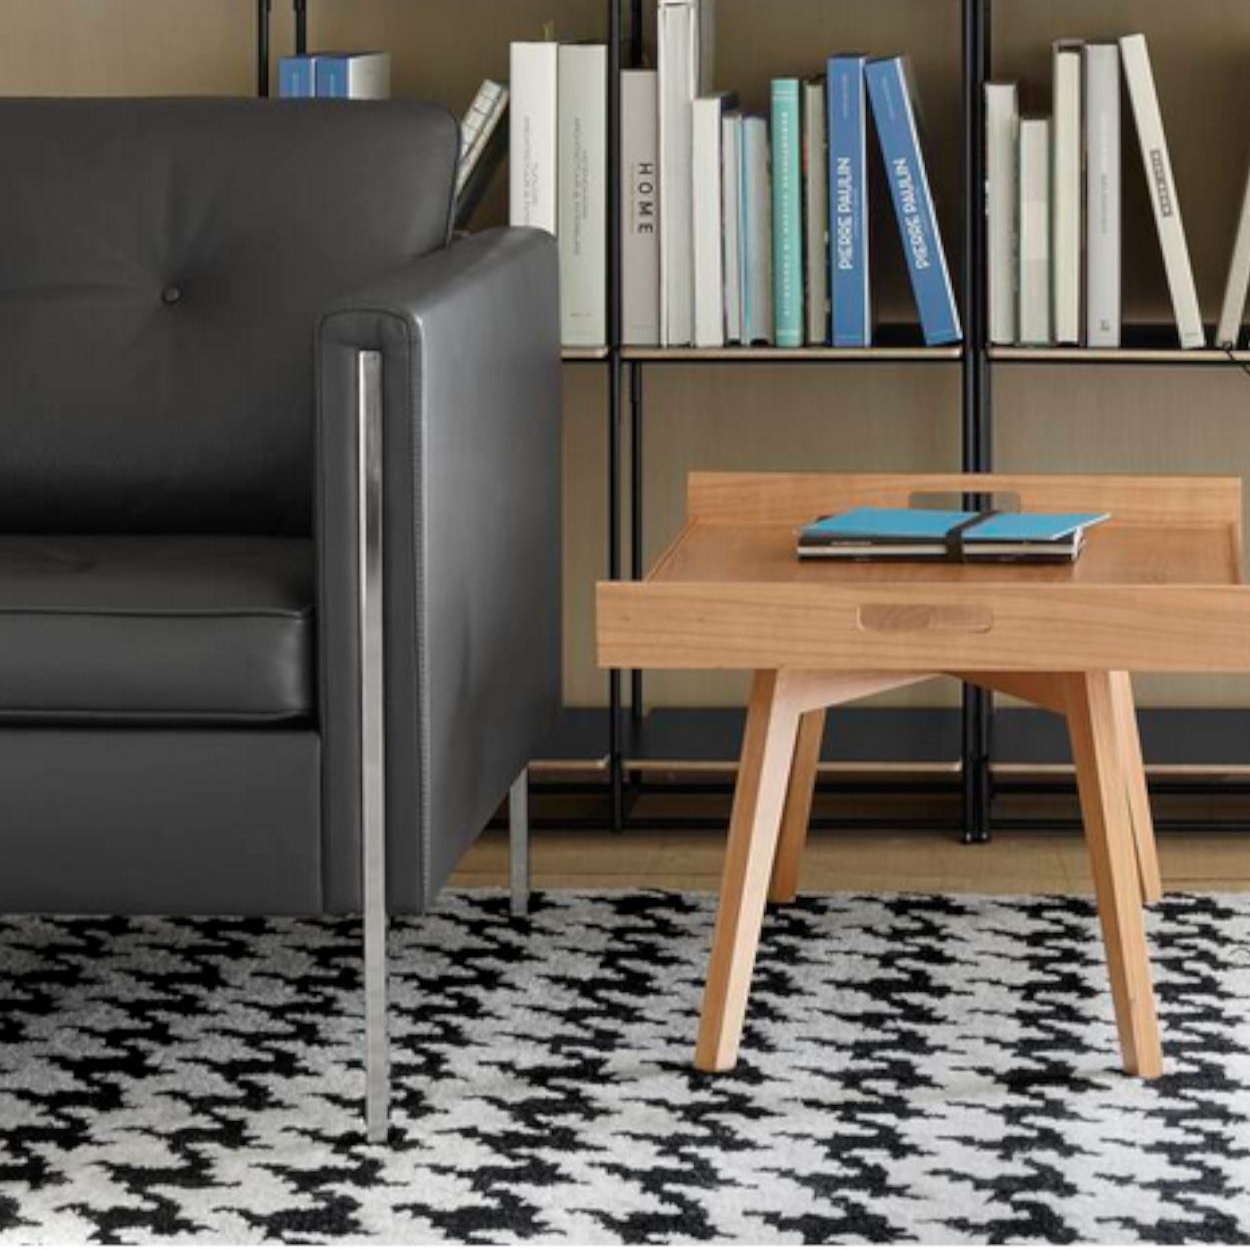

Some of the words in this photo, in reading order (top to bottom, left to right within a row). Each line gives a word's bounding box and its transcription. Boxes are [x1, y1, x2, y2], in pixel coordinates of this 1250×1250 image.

[638, 162, 654, 234] HOME
[837, 157, 853, 213] PAULIN
[893, 157, 917, 213] PAULIN
[837, 216, 853, 269] PIERRE
[904, 213, 930, 269] PIERRE
